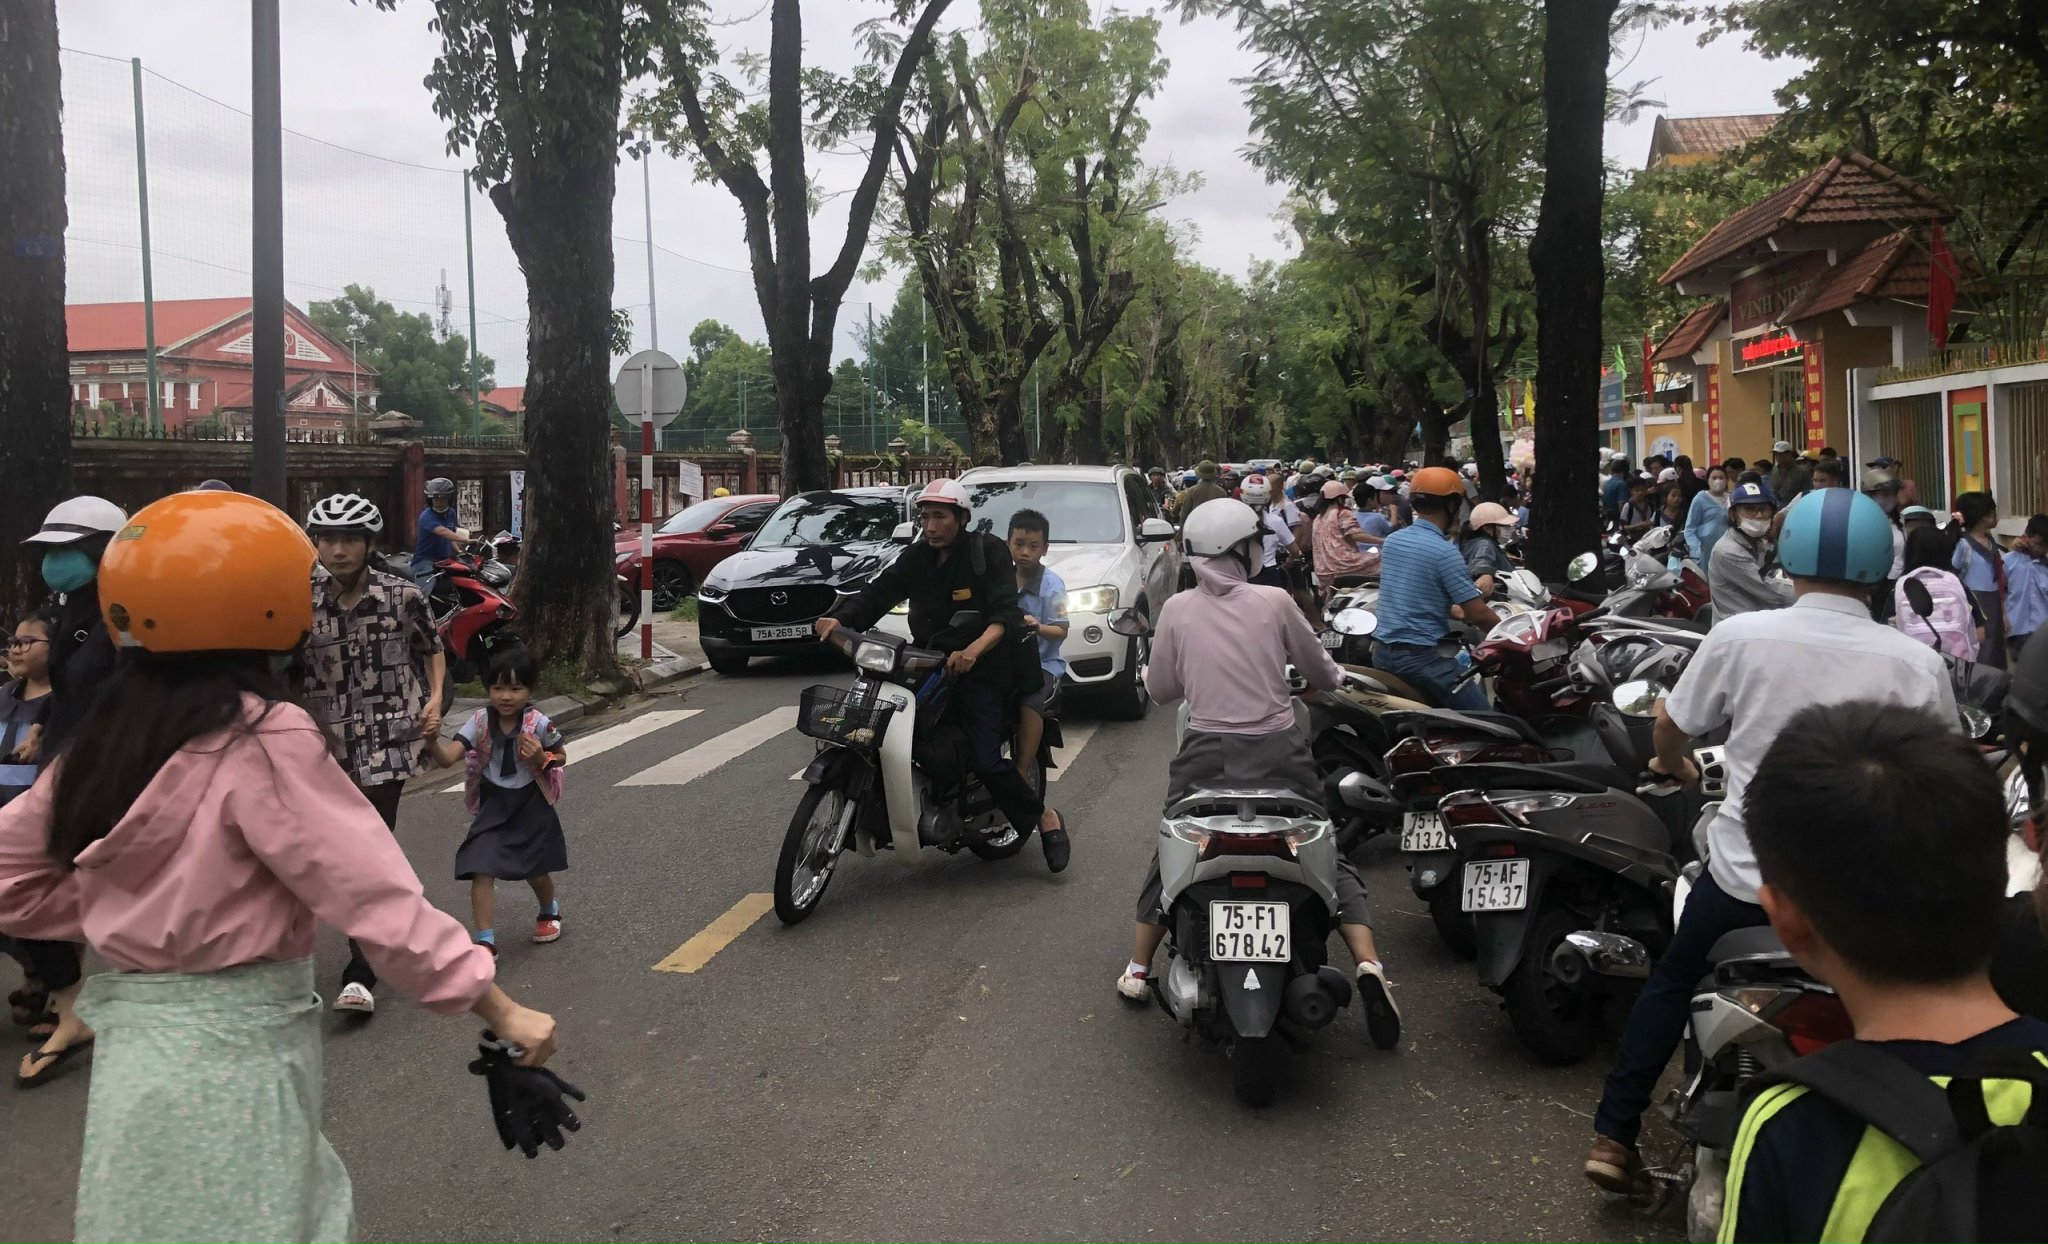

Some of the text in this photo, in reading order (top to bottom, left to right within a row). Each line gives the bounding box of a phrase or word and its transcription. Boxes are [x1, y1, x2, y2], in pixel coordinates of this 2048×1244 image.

[755, 626, 808, 640] 75A-269.58
[1403, 831, 1446, 850] 613.2
[1474, 862, 1519, 886] 75-AF
[1467, 884, 1523, 909] 154.37
[1222, 905, 1276, 930] 75-F1
[1215, 932, 1286, 958] 678.42
